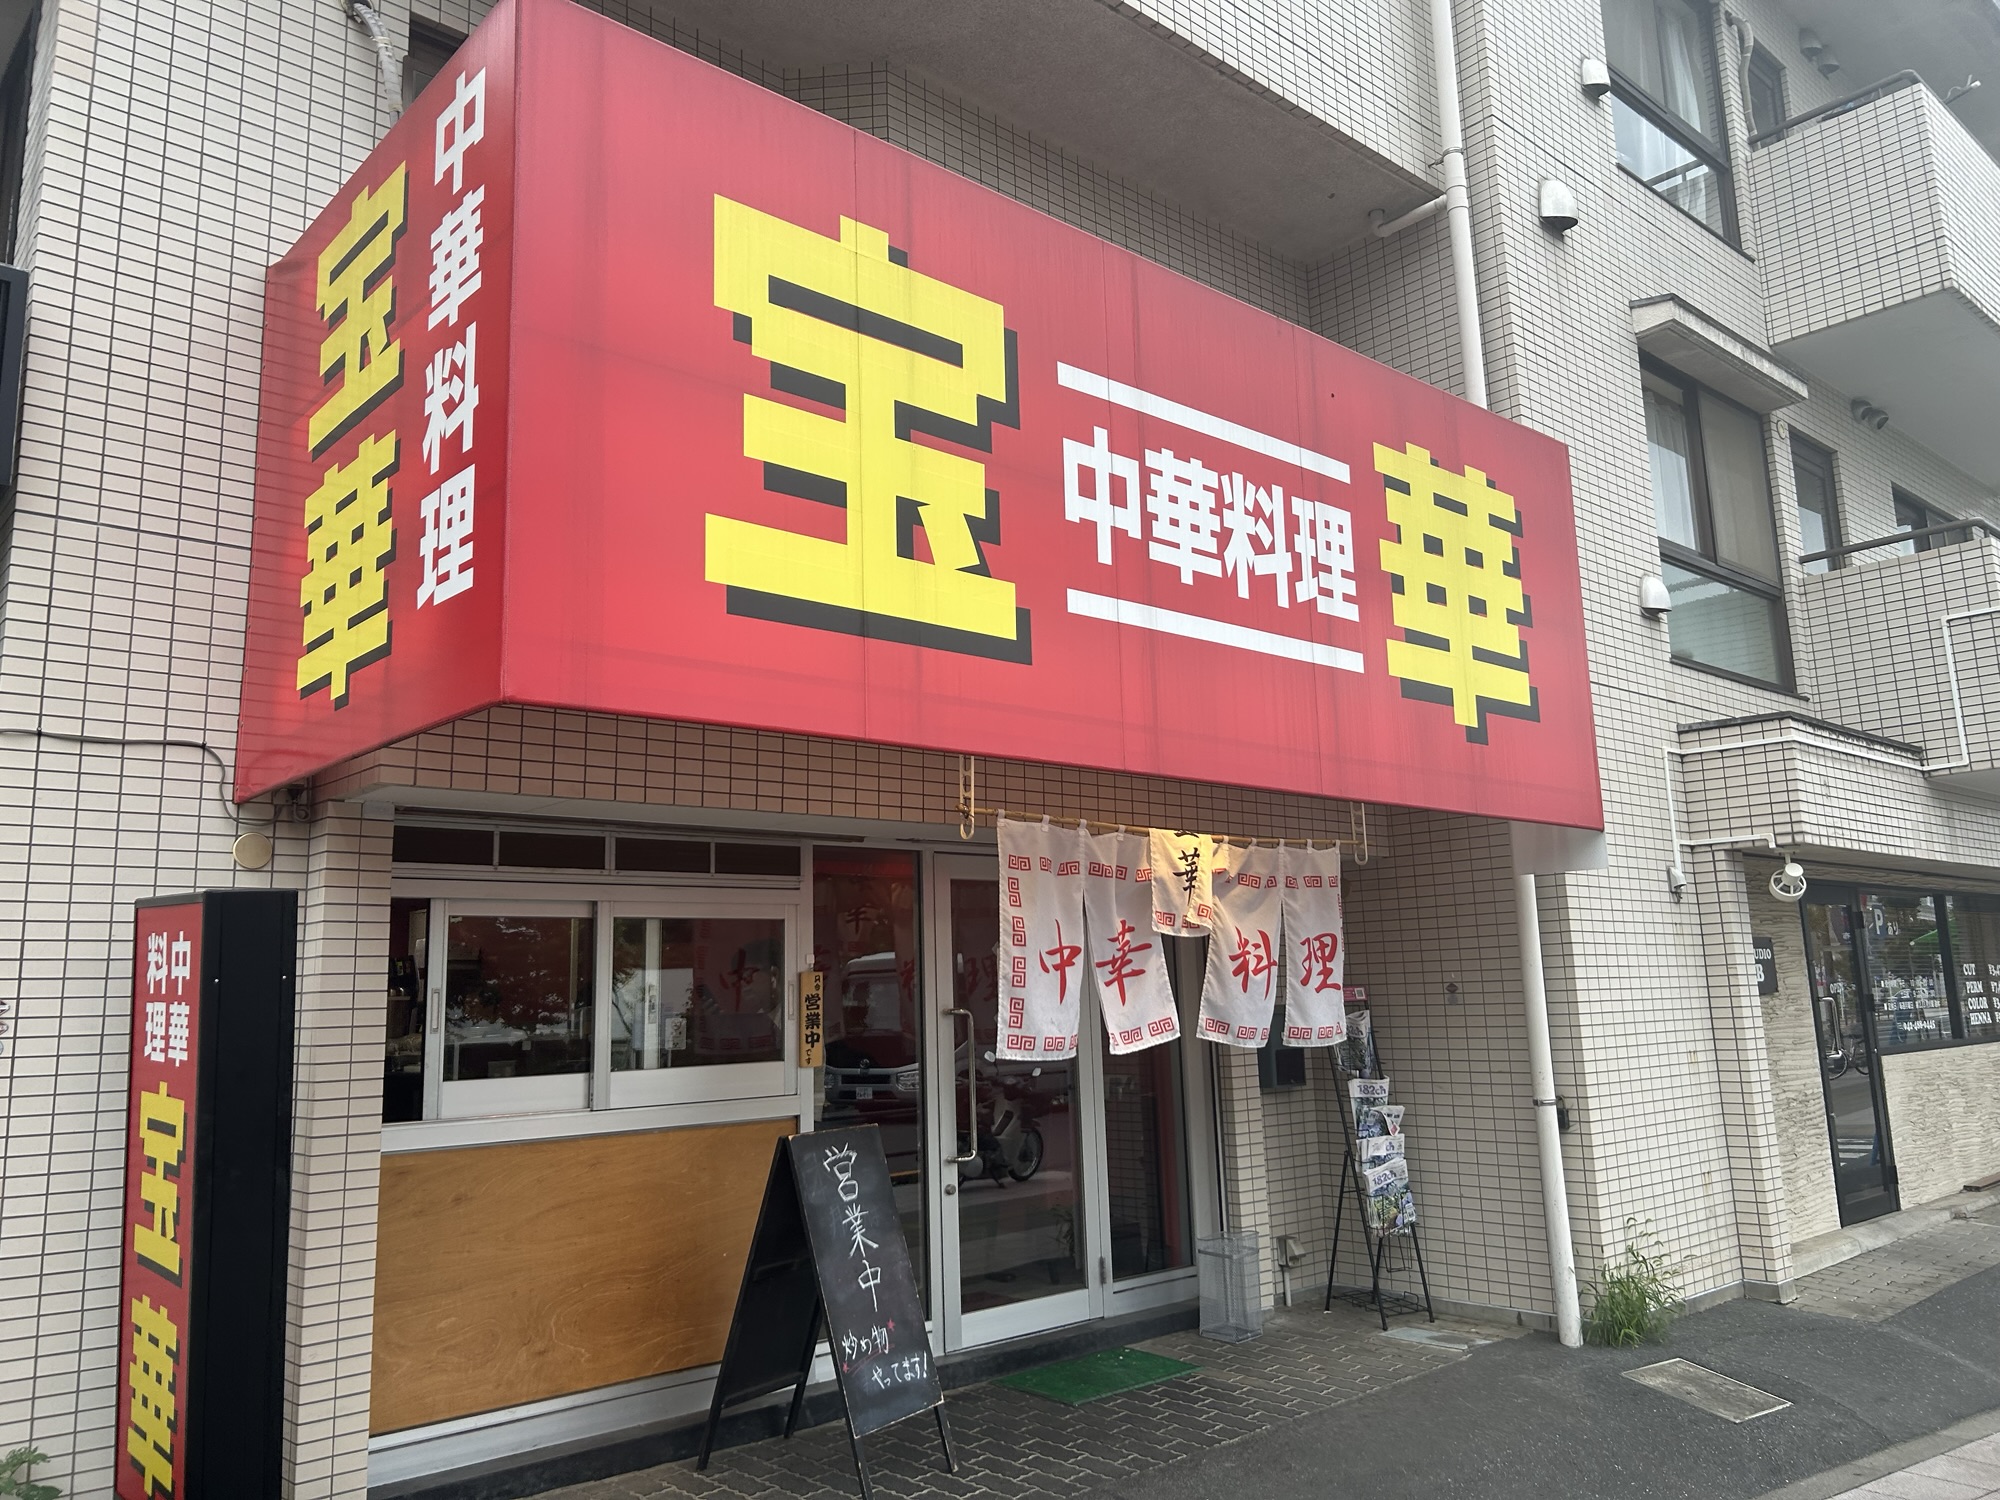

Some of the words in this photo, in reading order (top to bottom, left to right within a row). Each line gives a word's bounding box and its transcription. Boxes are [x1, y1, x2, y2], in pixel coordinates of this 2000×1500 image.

[415, 66, 487, 610] 中華料理
[296, 160, 407, 704] 宝華
[705, 194, 1020, 645] 宝
[1062, 425, 1361, 622] 中華料理
[1372, 440, 1532, 728] 華
[1039, 918, 1342, 1007] 中華料理
[1754, 948, 1772, 960] UDIO
[1963, 963, 1976, 976] CUT
[1965, 980, 1984, 994] PERM
[1967, 996, 1989, 1010] COLOR
[1969, 1011, 1993, 1026] HENNA
[1357, 1084, 1387, 1096] 182ch
[1372, 1169, 1397, 1185] 182ch
[823, 1142, 880, 1313] 営業中
[127, 1081, 185, 1498] 宝華
[841, 1323, 889, 1361] 炒め物
